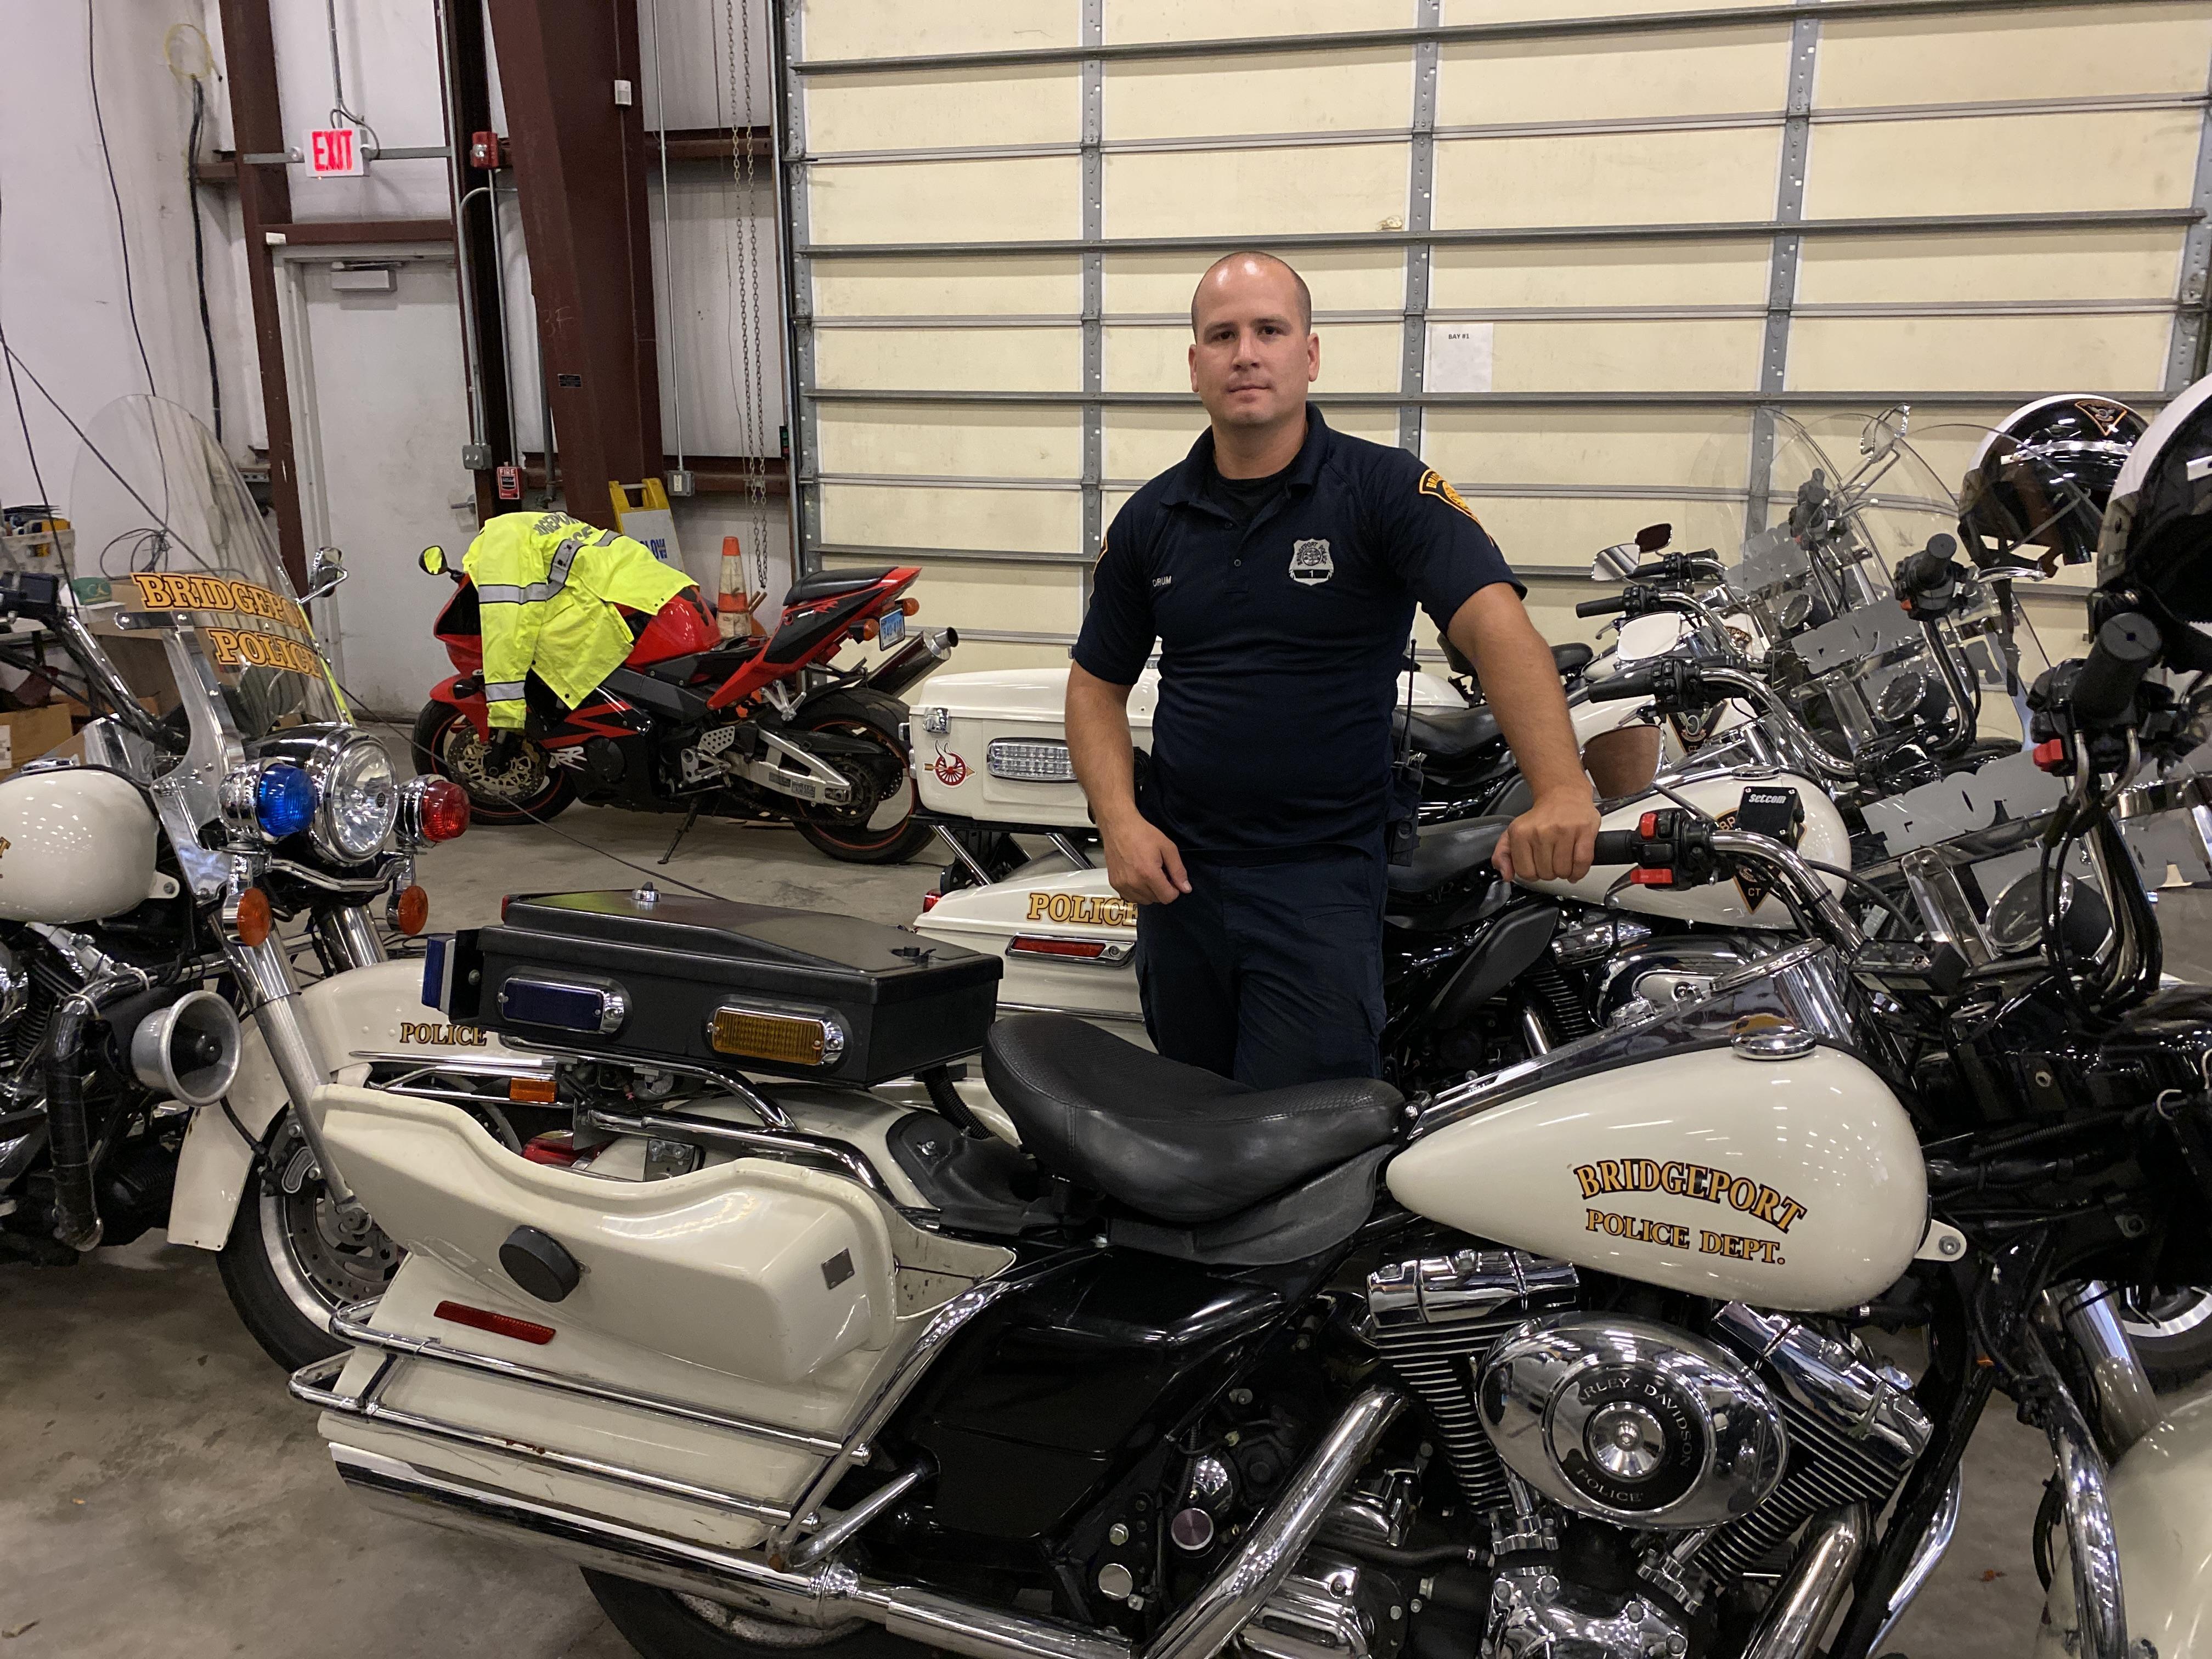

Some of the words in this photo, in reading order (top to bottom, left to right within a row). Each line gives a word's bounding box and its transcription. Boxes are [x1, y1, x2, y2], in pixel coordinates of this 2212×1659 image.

[312, 130, 353, 171] EXIT
[1309, 569, 1314, 578] 1
[206, 628, 325, 680] POLICE
[1748, 887, 1761, 896] CT
[399, 1022, 487, 1046] POLICE
[1573, 1158, 1807, 1234] BRIDGEPORT
[1585, 1208, 1690, 1250] POLICE
[1699, 1229, 1786, 1265] DEPT.
[1576, 1468, 1642, 1502] POLICE
